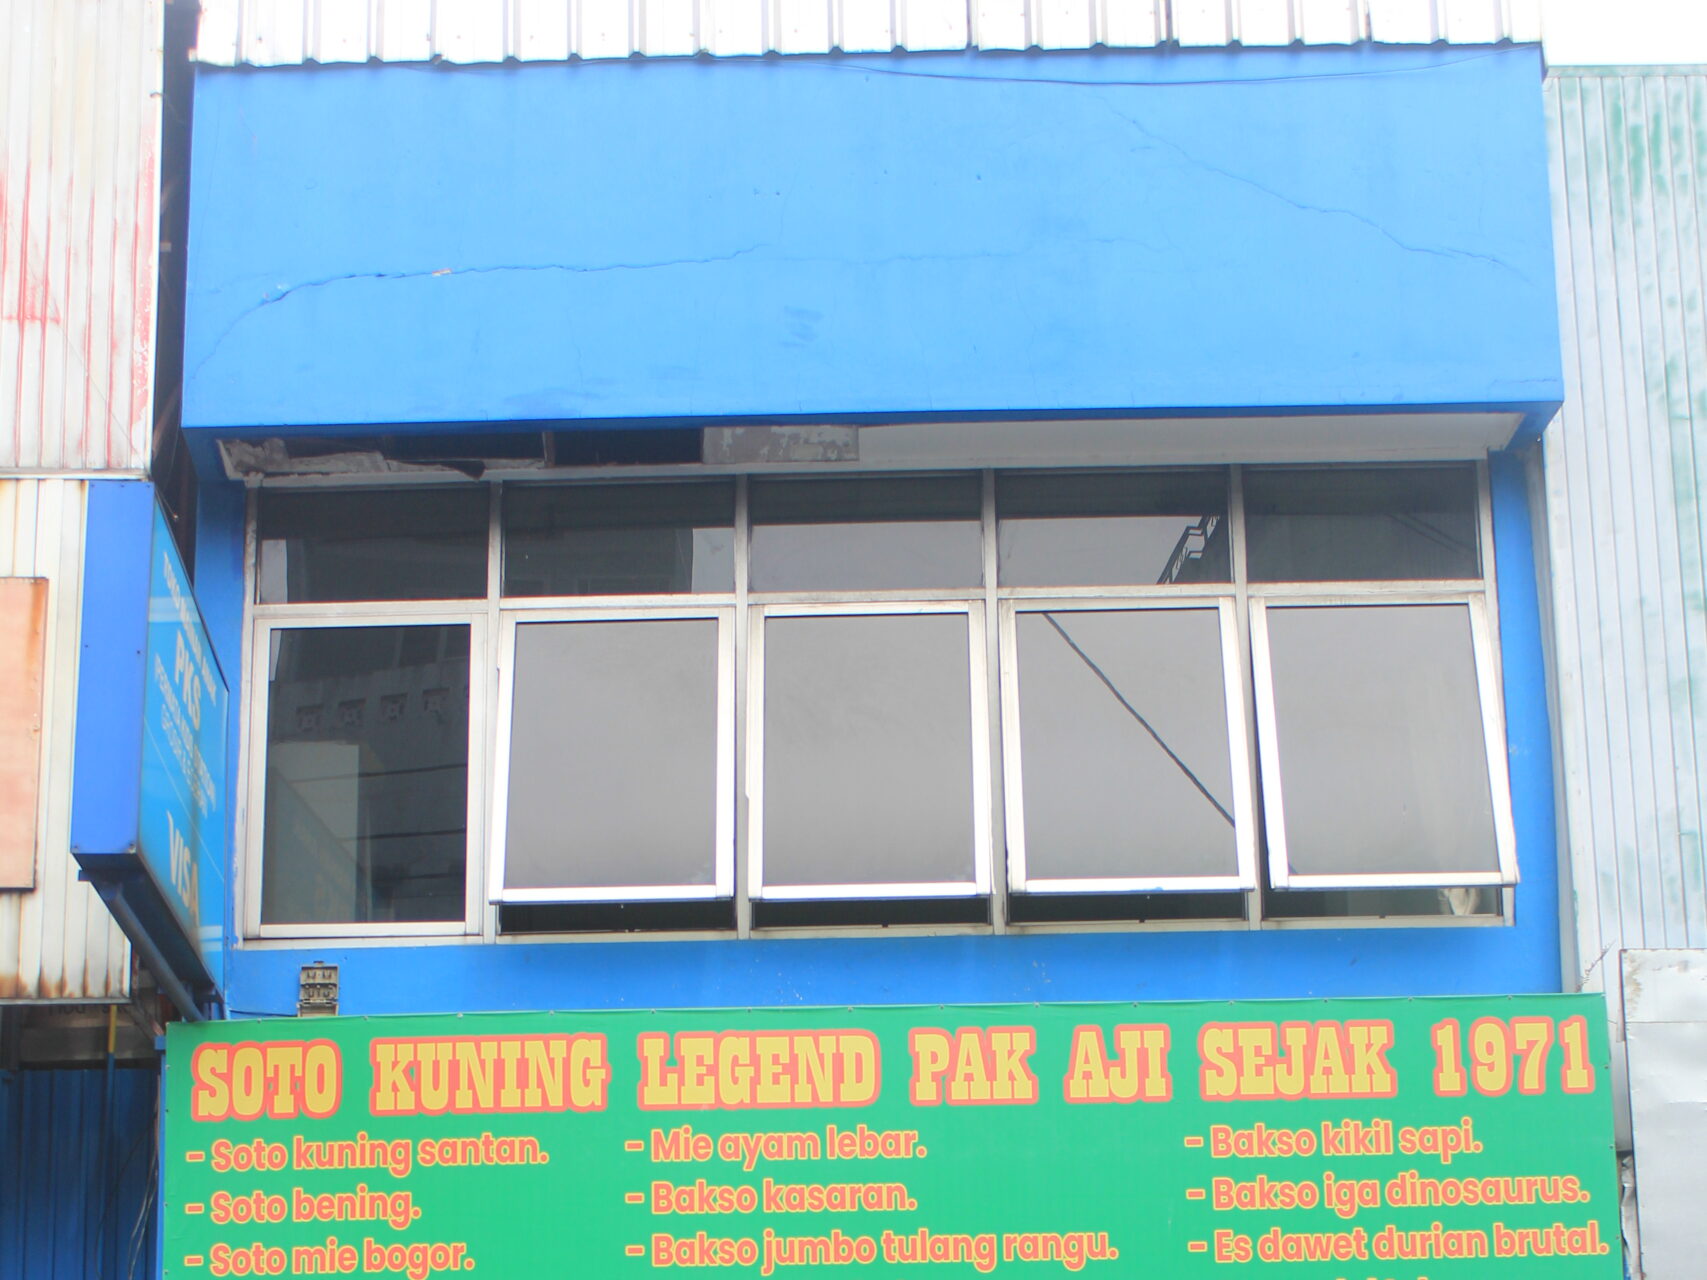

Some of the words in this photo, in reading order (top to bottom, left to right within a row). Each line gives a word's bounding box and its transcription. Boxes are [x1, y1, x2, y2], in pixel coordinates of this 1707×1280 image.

[175, 628, 201, 731] PKS
[166, 809, 201, 922] VISA
[192, 1038, 342, 1121] SOTO
[370, 1033, 610, 1116] KUNING
[638, 1028, 882, 1111] LEGEND
[910, 1024, 1038, 1106] PAK
[1064, 1023, 1171, 1102] AJI
[1199, 1019, 1397, 1101] SEJAK
[1432, 1015, 1595, 1097] 1971
[211, 1137, 288, 1173] Soto
[293, 1131, 412, 1178] kuning
[418, 1133, 550, 1167] santan.
[651, 1126, 714, 1164] Mie
[718, 1130, 821, 1171] ayam
[826, 1123, 928, 1160] lebar.
[1211, 1123, 1317, 1158] Bakso
[1322, 1118, 1393, 1156] kikil
[1399, 1116, 1483, 1164] sapi.
[211, 1190, 288, 1225] Soto
[293, 1184, 422, 1230] bening.
[651, 1180, 757, 1215] Bakso
[763, 1175, 918, 1213] kasaran.
[1212, 1177, 1318, 1212] Bakso
[1324, 1173, 1380, 1218] iga
[1385, 1169, 1590, 1208] dinosaurus.
[210, 1242, 287, 1277] Soto
[292, 1237, 359, 1273] mie
[651, 1232, 758, 1268] Bakso
[762, 1231, 878, 1277] jumbo
[882, 1228, 996, 1273] tulang
[1003, 1230, 1119, 1271] rangu.
[1214, 1230, 1253, 1264] Es
[1259, 1226, 1368, 1263] dawet
[1374, 1222, 1490, 1260] durian
[1494, 1219, 1609, 1257] brutal.
